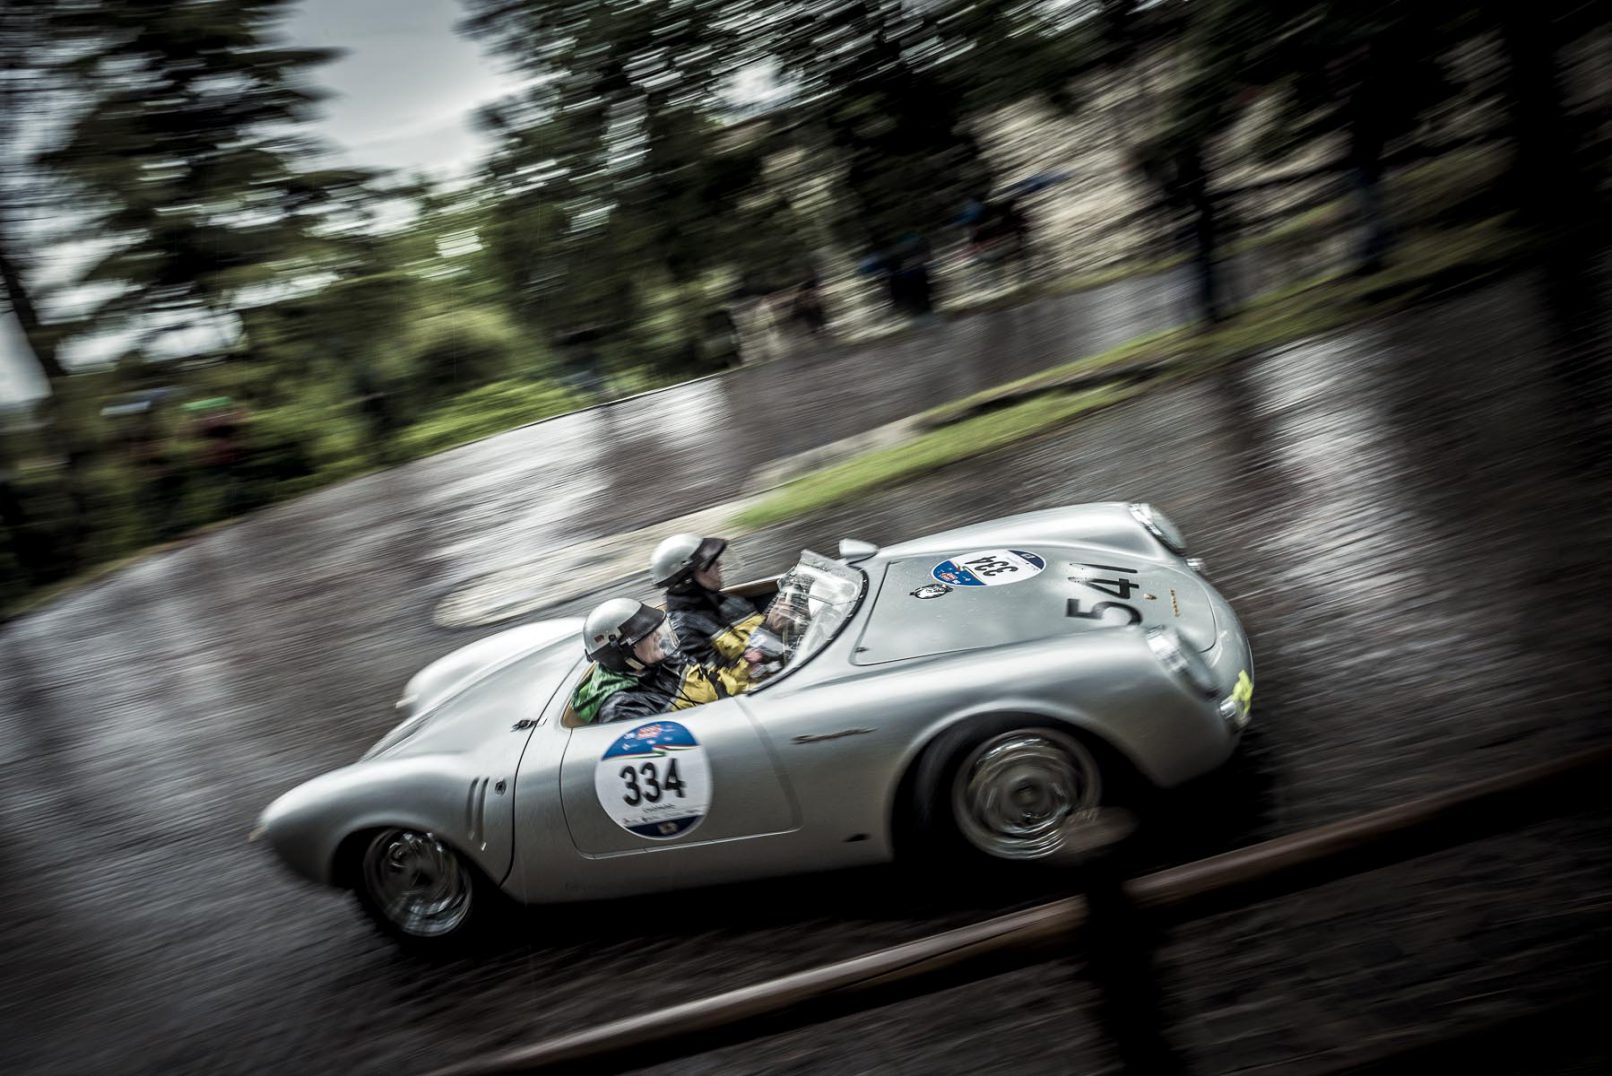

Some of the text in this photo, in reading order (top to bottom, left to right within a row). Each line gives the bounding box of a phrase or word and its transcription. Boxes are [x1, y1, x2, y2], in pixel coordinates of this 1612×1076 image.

[964, 555, 1019, 577] 334
[1066, 562, 1143, 626] 541
[619, 758, 687, 807] 334
